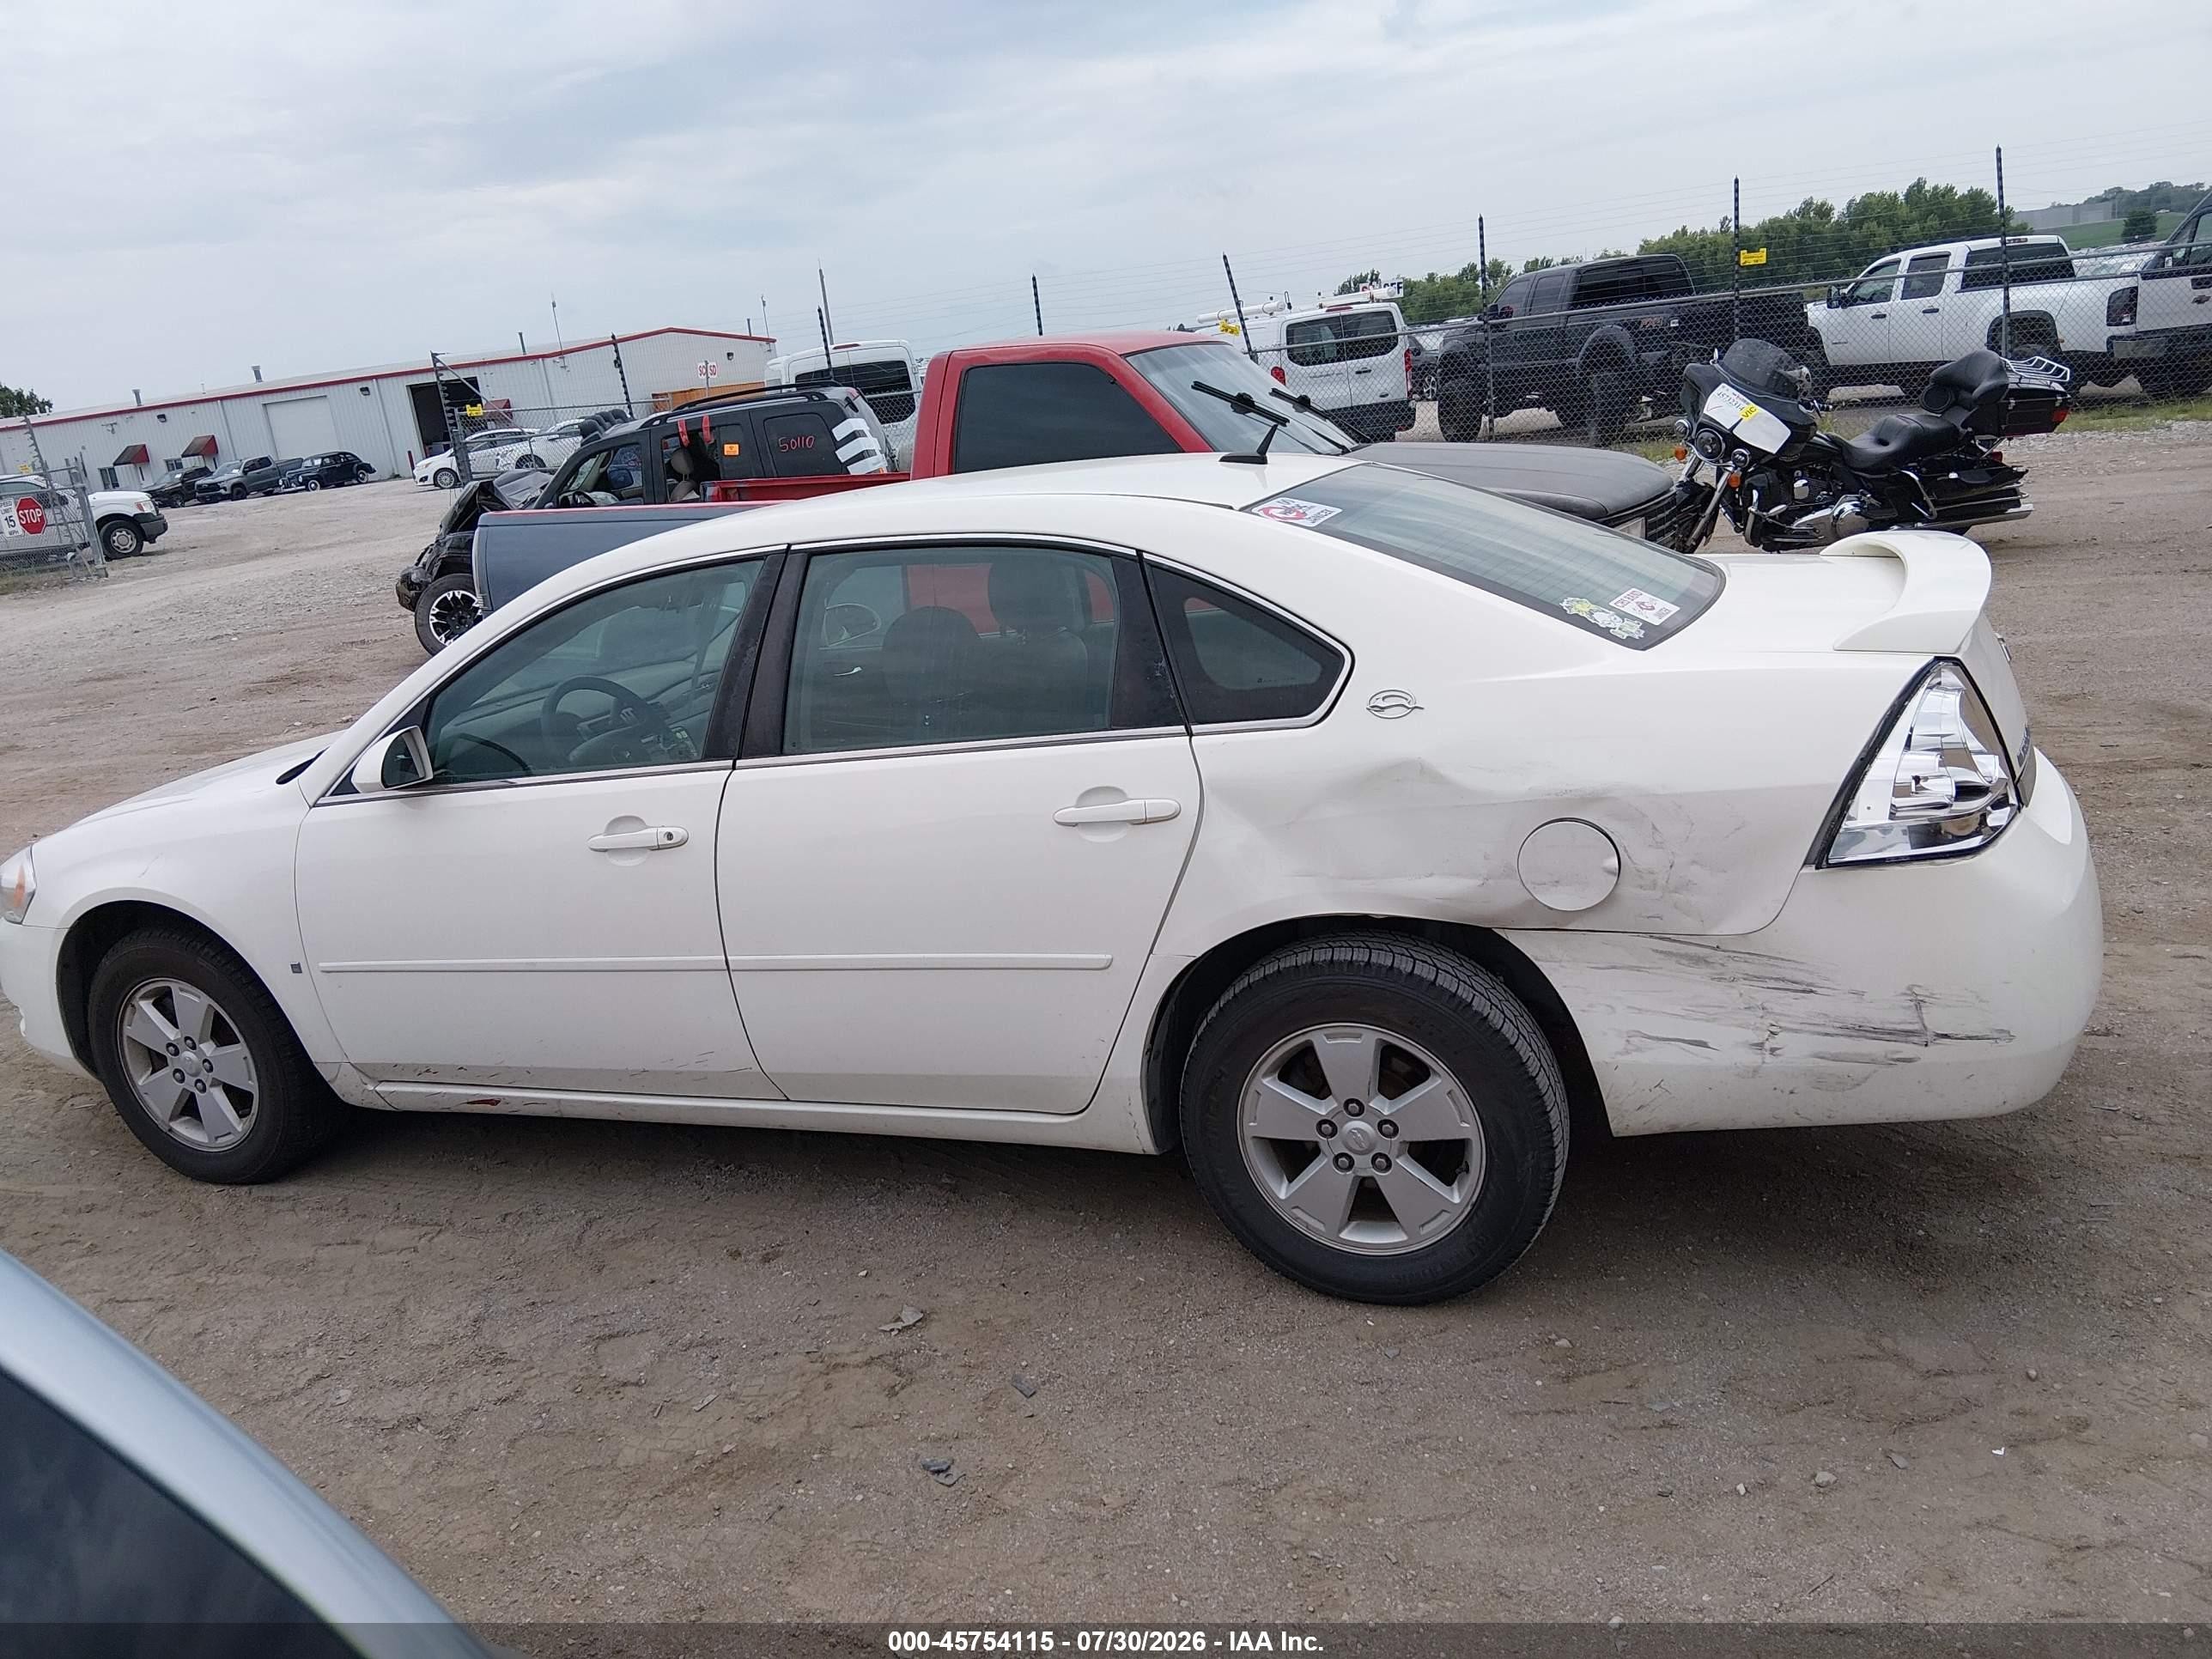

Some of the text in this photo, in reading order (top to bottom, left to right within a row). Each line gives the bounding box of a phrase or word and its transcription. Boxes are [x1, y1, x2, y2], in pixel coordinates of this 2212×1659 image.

[1741, 406, 1757, 418] VIC
[778, 435, 815, 453] 50110
[4, 515, 16, 529] 15
[18, 508, 42, 525] STOP
